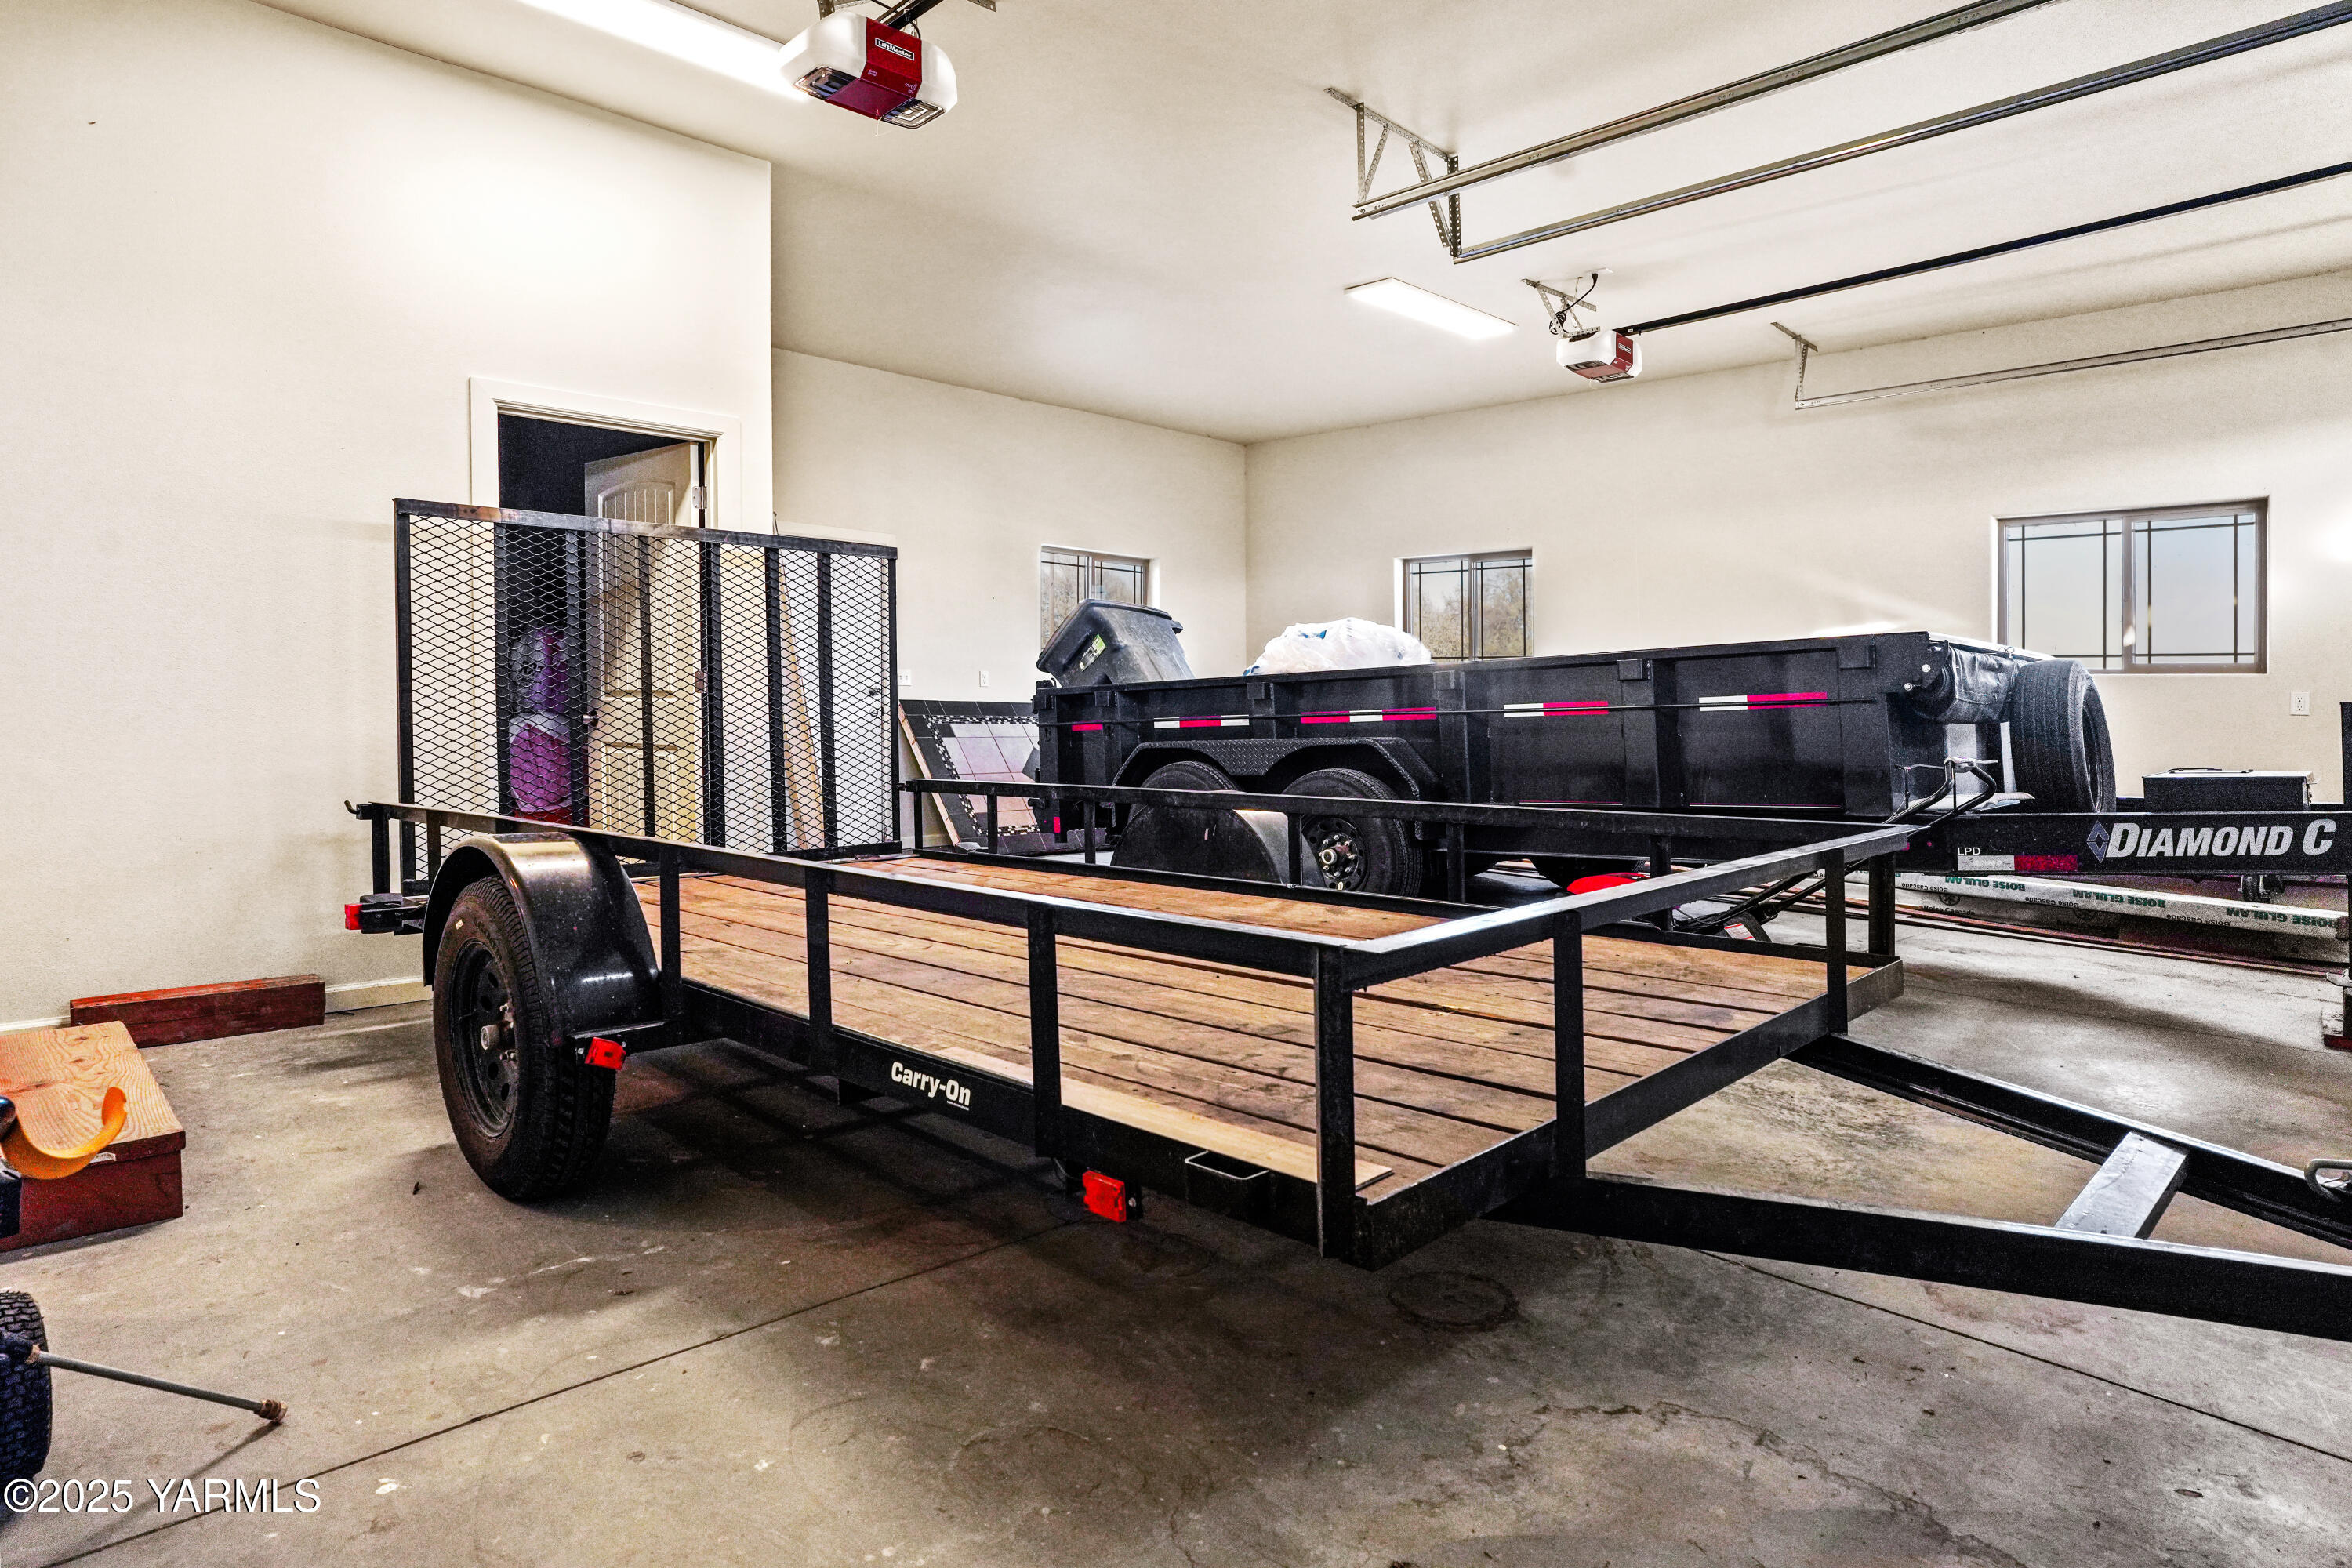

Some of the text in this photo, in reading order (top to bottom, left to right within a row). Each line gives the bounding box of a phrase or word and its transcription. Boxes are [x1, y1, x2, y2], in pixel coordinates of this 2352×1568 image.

[877, 39, 912, 59] LiftMaster
[2105, 818, 2336, 858] DIAMOND C
[1957, 847, 1981, 855] LPD
[1944, 876, 2026, 891] BOISE GLULAM
[2025, 896, 2079, 908] Boise Cascade
[2072, 889, 2166, 908] BOISE GLULAM
[2226, 907, 2288, 923] GLULAM
[891, 1061, 971, 1106] Carry-On
